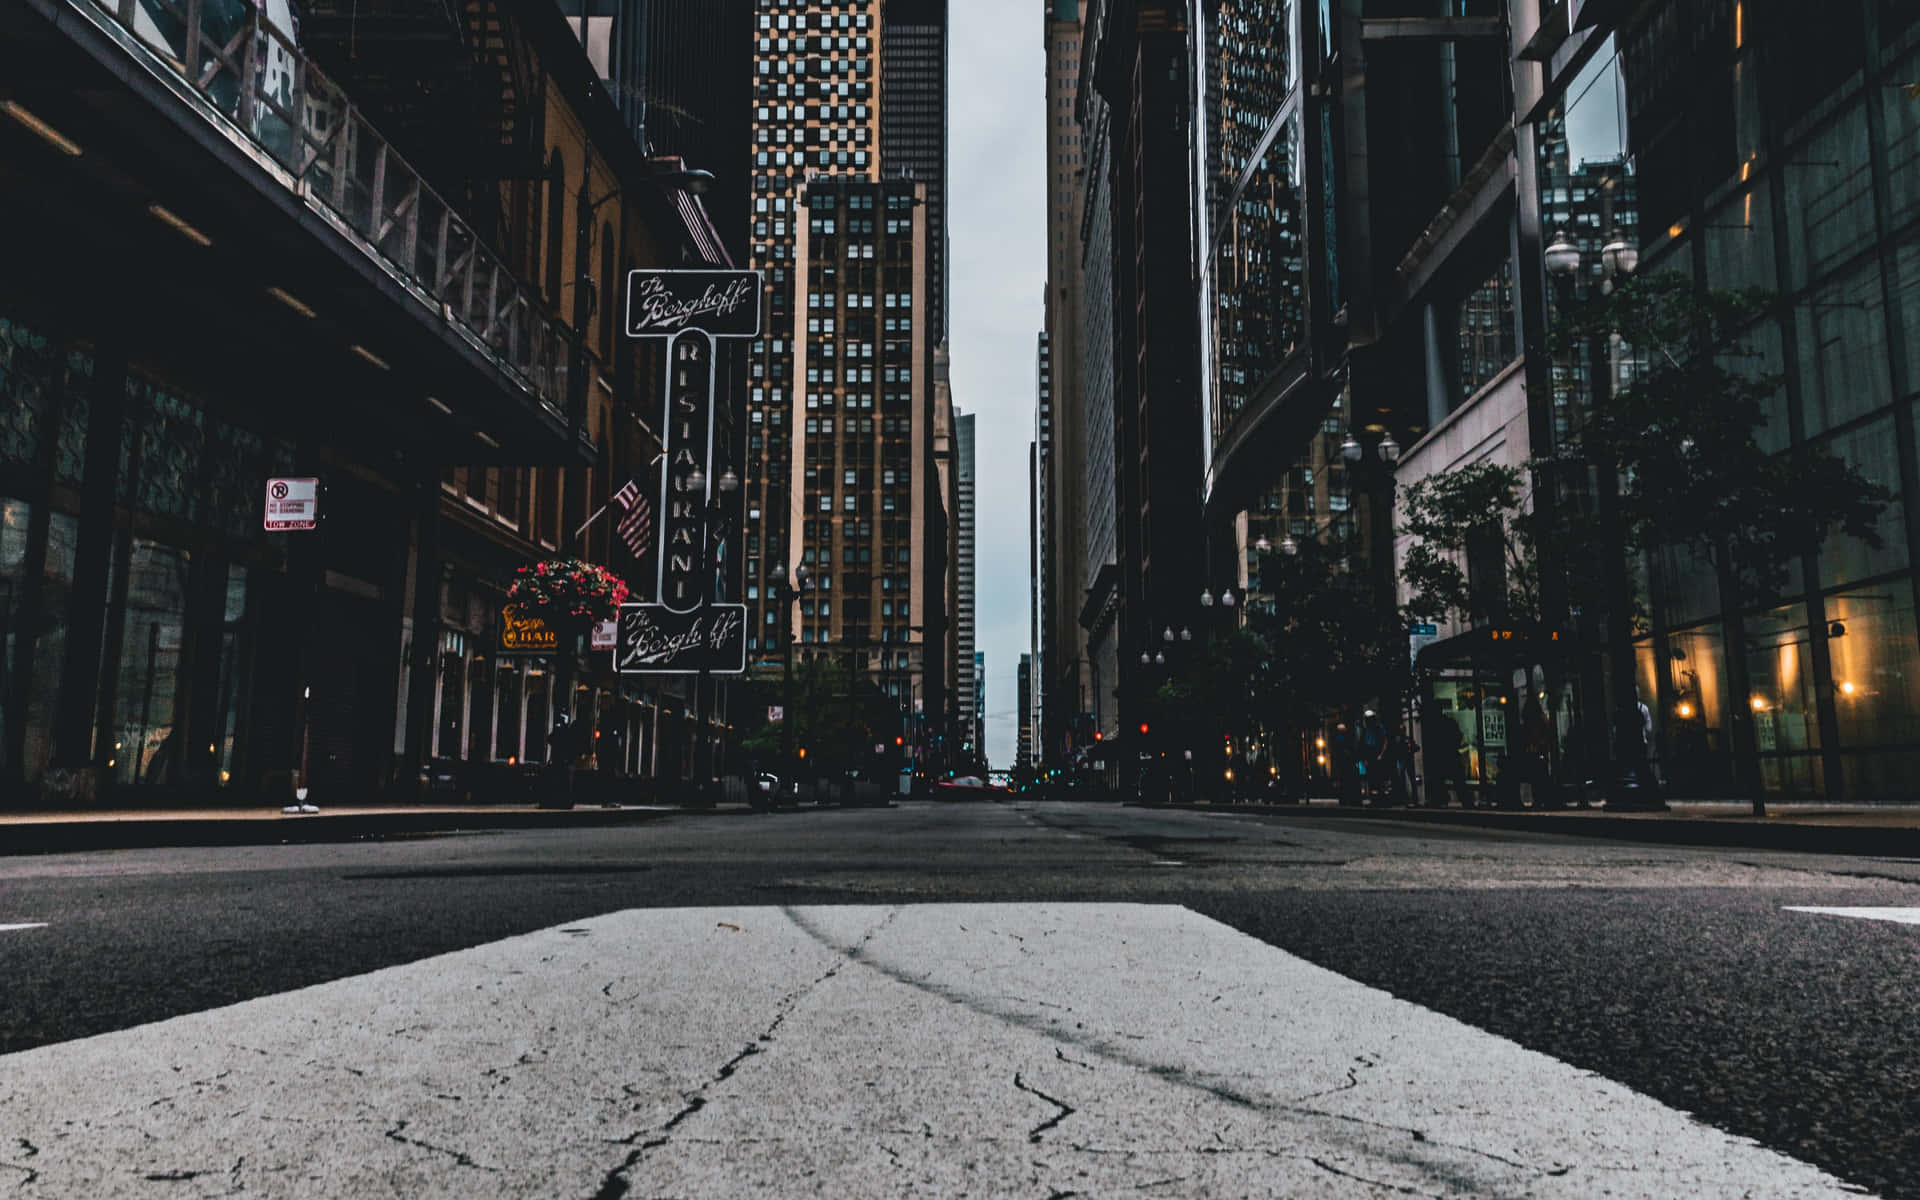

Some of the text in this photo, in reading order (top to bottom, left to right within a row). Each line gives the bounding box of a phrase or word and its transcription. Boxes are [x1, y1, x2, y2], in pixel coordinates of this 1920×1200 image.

[270, 520, 309, 528] TOW ZONE
[620, 611, 741, 667] Berghff
